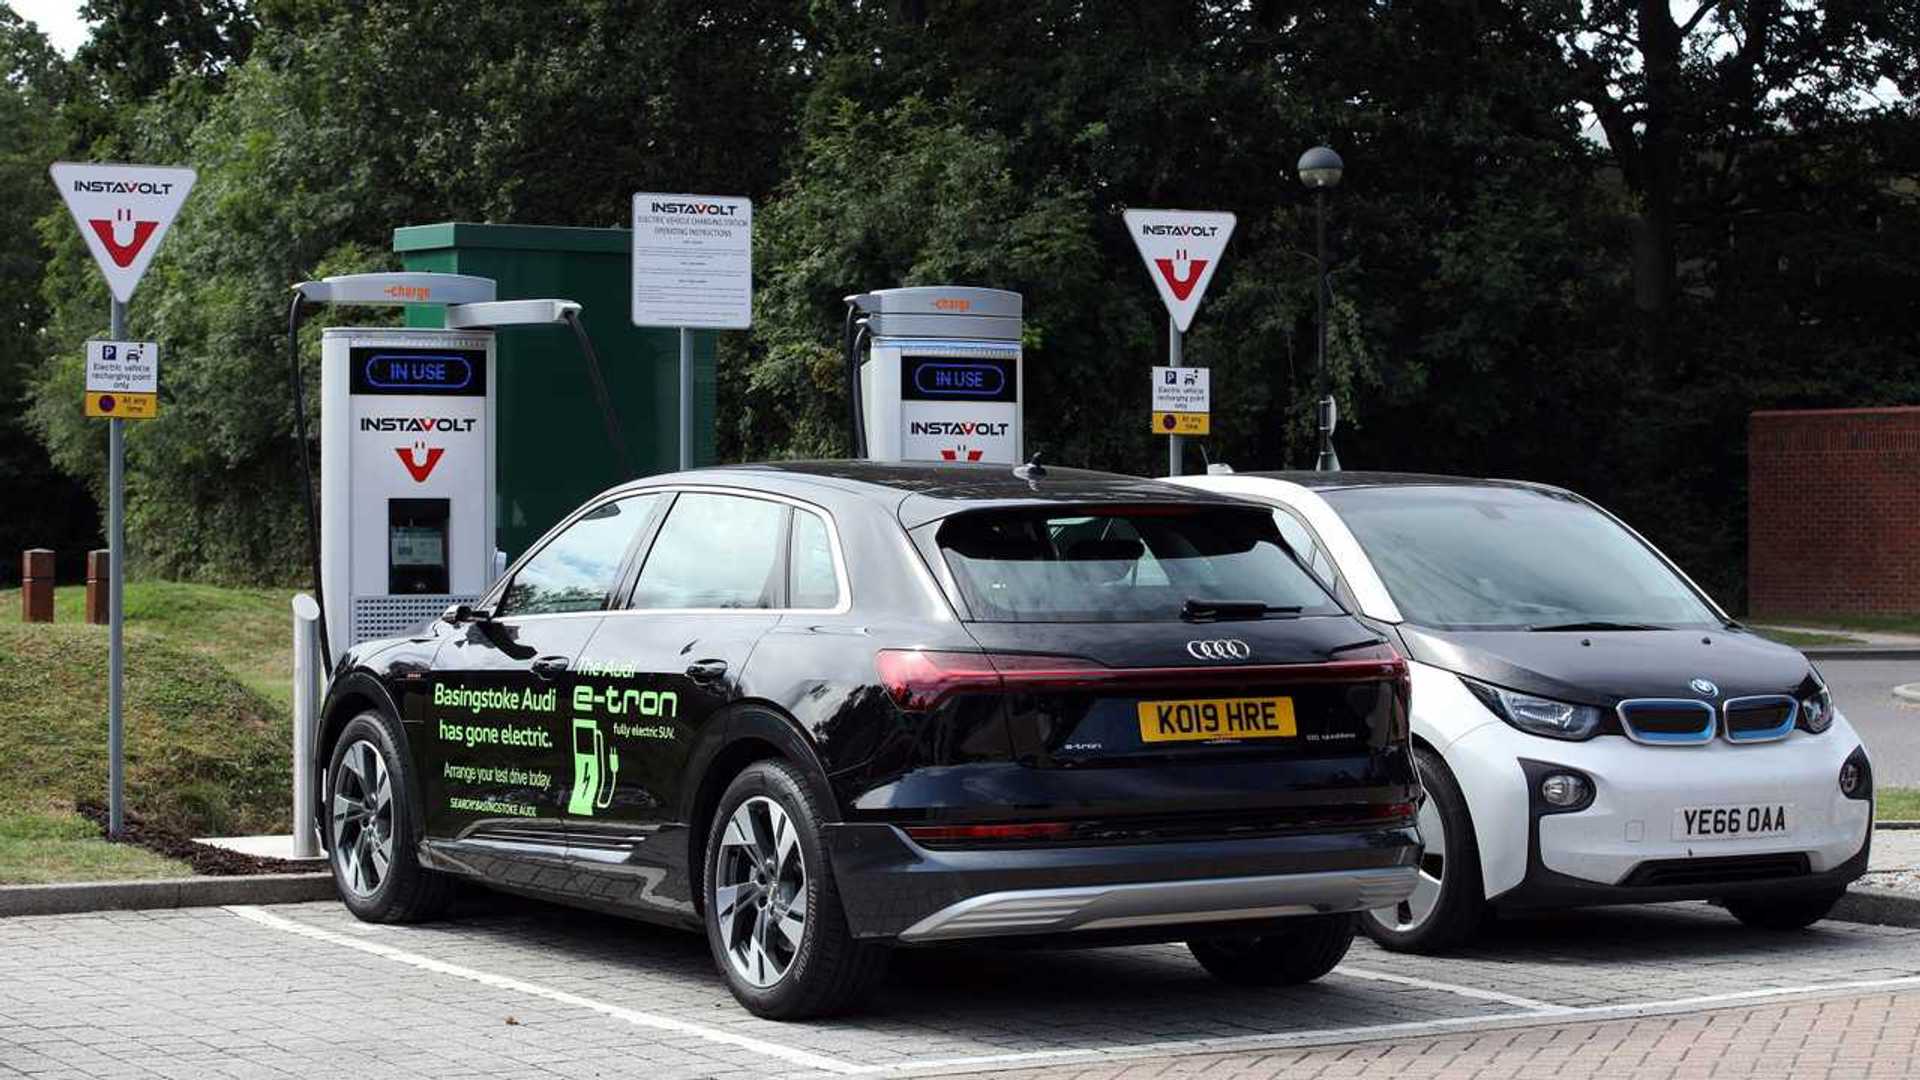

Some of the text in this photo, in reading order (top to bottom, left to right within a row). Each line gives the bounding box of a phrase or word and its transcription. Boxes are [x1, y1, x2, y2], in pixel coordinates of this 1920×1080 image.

[74, 180, 173, 195] INSTAVOLT
[652, 202, 738, 216] INSTAVOLT
[1142, 224, 1218, 237] INSTAVOLT
[390, 362, 446, 380] IN USE
[936, 370, 984, 387] IN USE
[360, 417, 477, 432] INSTAVOLT
[911, 421, 1009, 436] INSTAVOLT
[577, 656, 640, 679] The Audi
[433, 682, 557, 714] Basingstoke Audi
[573, 685, 678, 718] e-tron
[1156, 701, 1279, 735] KO19 HRE
[439, 718, 554, 748] has gone electric.
[613, 722, 631, 739] fully
[631, 723, 658, 738] electric
[443, 761, 477, 784] Arrange
[477, 766, 494, 785] your
[494, 766, 508, 783] test
[509, 767, 528, 786] drive
[1684, 805, 1786, 835] YE66 OAA
